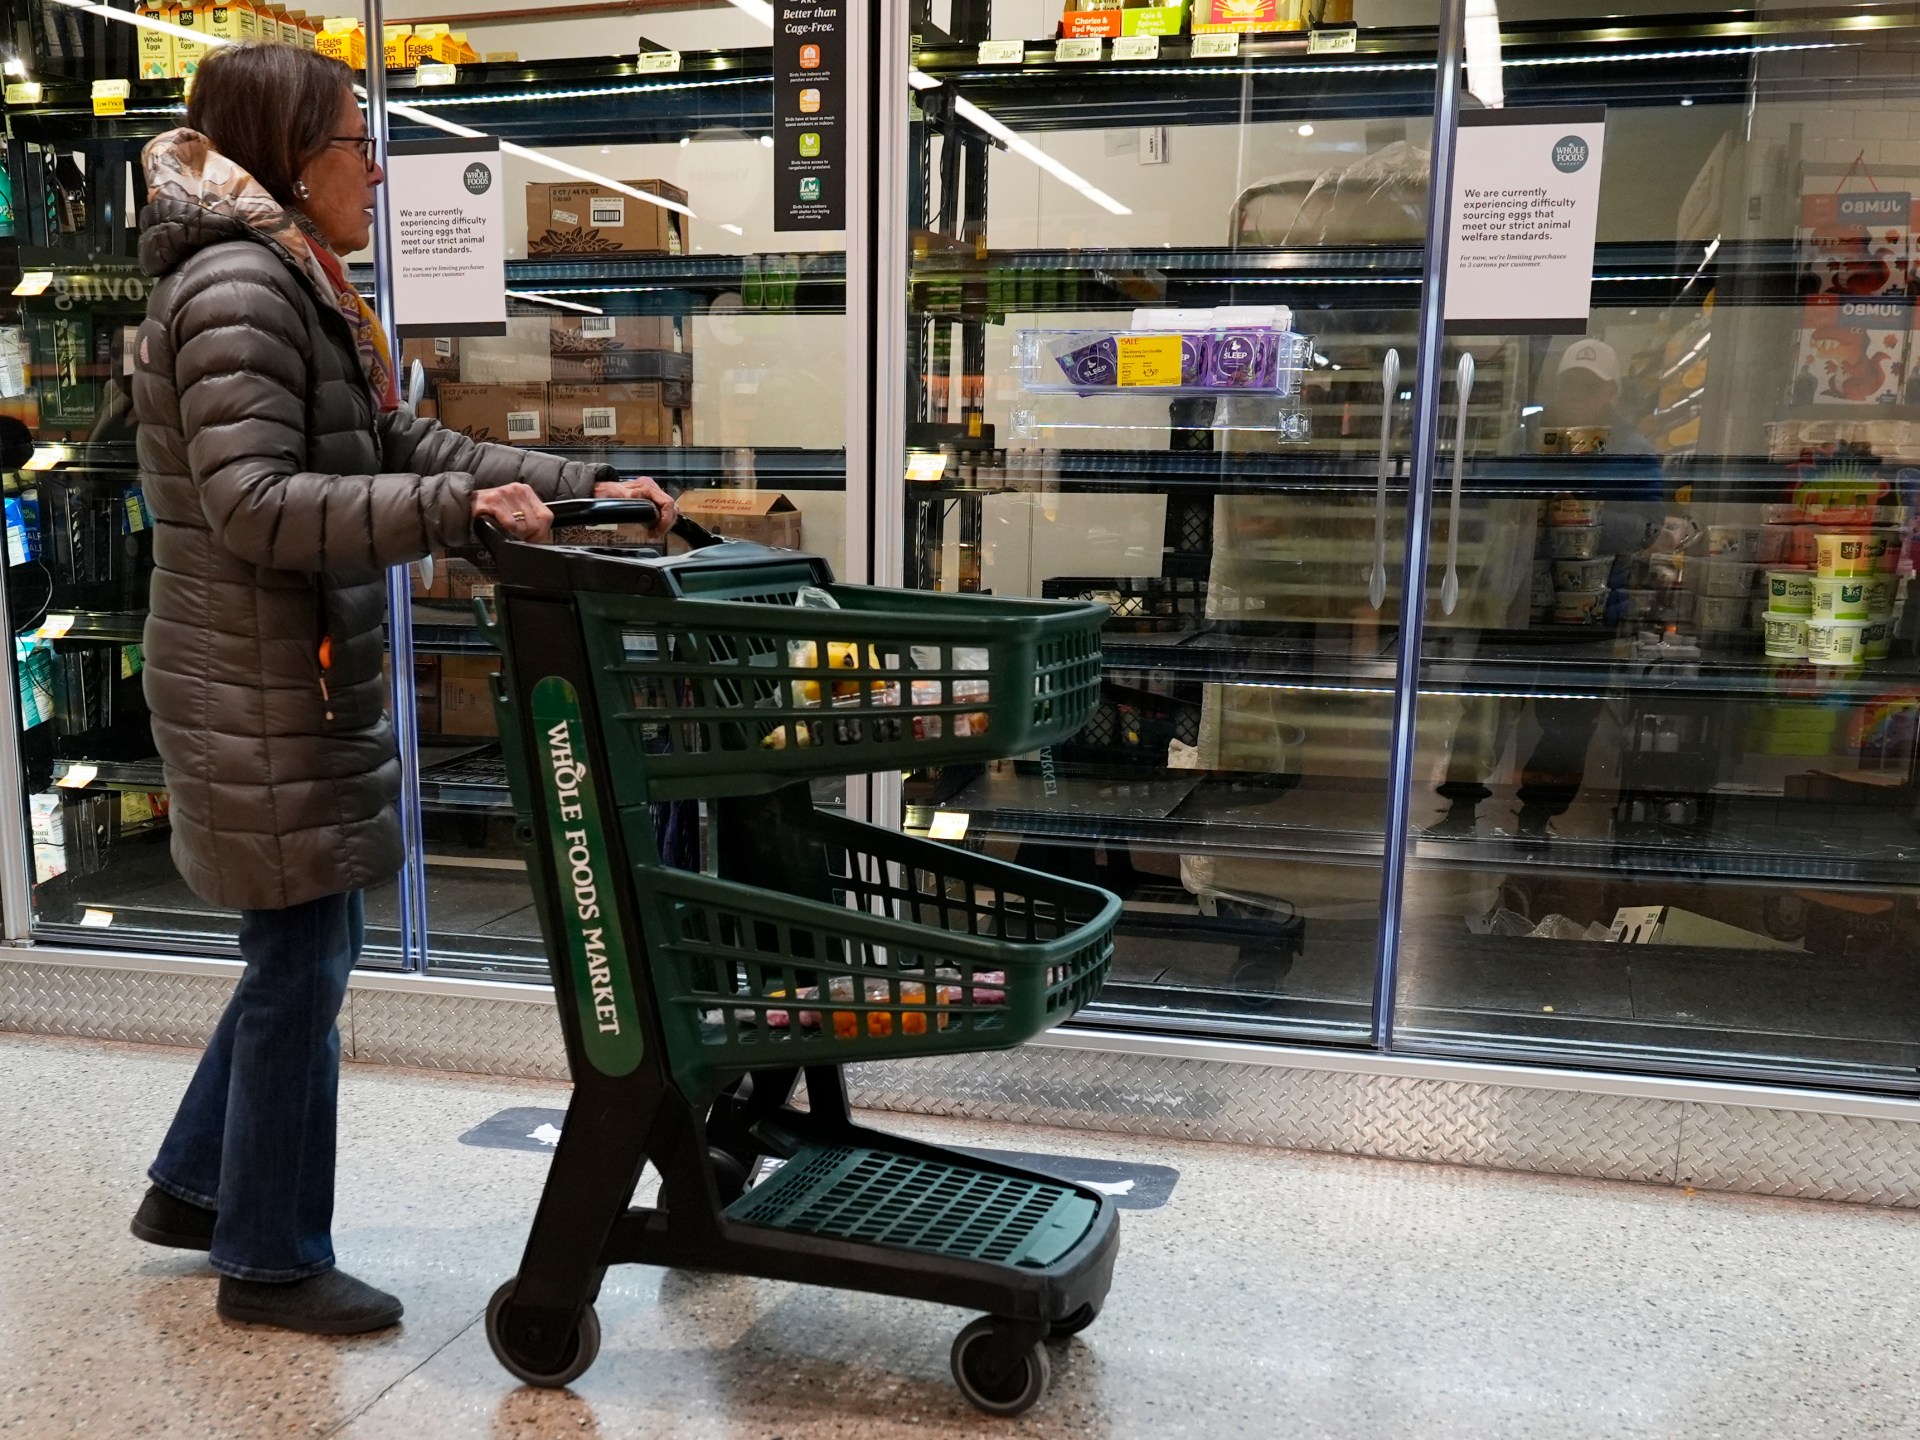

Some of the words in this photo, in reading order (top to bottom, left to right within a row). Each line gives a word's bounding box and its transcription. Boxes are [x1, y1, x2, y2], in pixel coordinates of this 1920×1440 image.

[181, 12, 192, 20] 365
[783, 9, 812, 19] Better
[814, 7, 836, 18] than
[785, 23, 834, 35] Cage-Free.
[1086, 25, 1110, 33] Pepper
[317, 38, 341, 48] Eggs
[384, 45, 396, 55] gs
[408, 45, 433, 54] Eggs
[1556, 146, 1585, 154] WHOLE
[466, 171, 489, 179] WHOLE
[1465, 189, 1480, 197] We
[1502, 188, 1547, 198] currently
[1464, 200, 1528, 210] experiencing
[1531, 198, 1576, 208] difficulty
[429, 208, 463, 216] currently
[1463, 211, 1505, 220] sourcing
[1508, 212, 1531, 220] eggs
[400, 218, 449, 227] experiencing
[452, 217, 486, 225] difficulty
[1509, 221, 1534, 229] strict
[1538, 220, 1570, 228] animal
[401, 228, 433, 237] sourcing
[436, 228, 453, 236] eggs
[1462, 233, 1498, 241] welfare
[1501, 232, 1552, 240] standards.
[583, 356, 629, 368] CALIFIA
[1084, 365, 1106, 377] SLEEP
[1843, 545, 1859, 554] 365
[1844, 589, 1859, 597] 365
[547, 720, 584, 822] WHOLE
[566, 829, 600, 920] FOODS
[582, 928, 620, 1035] MARKET
